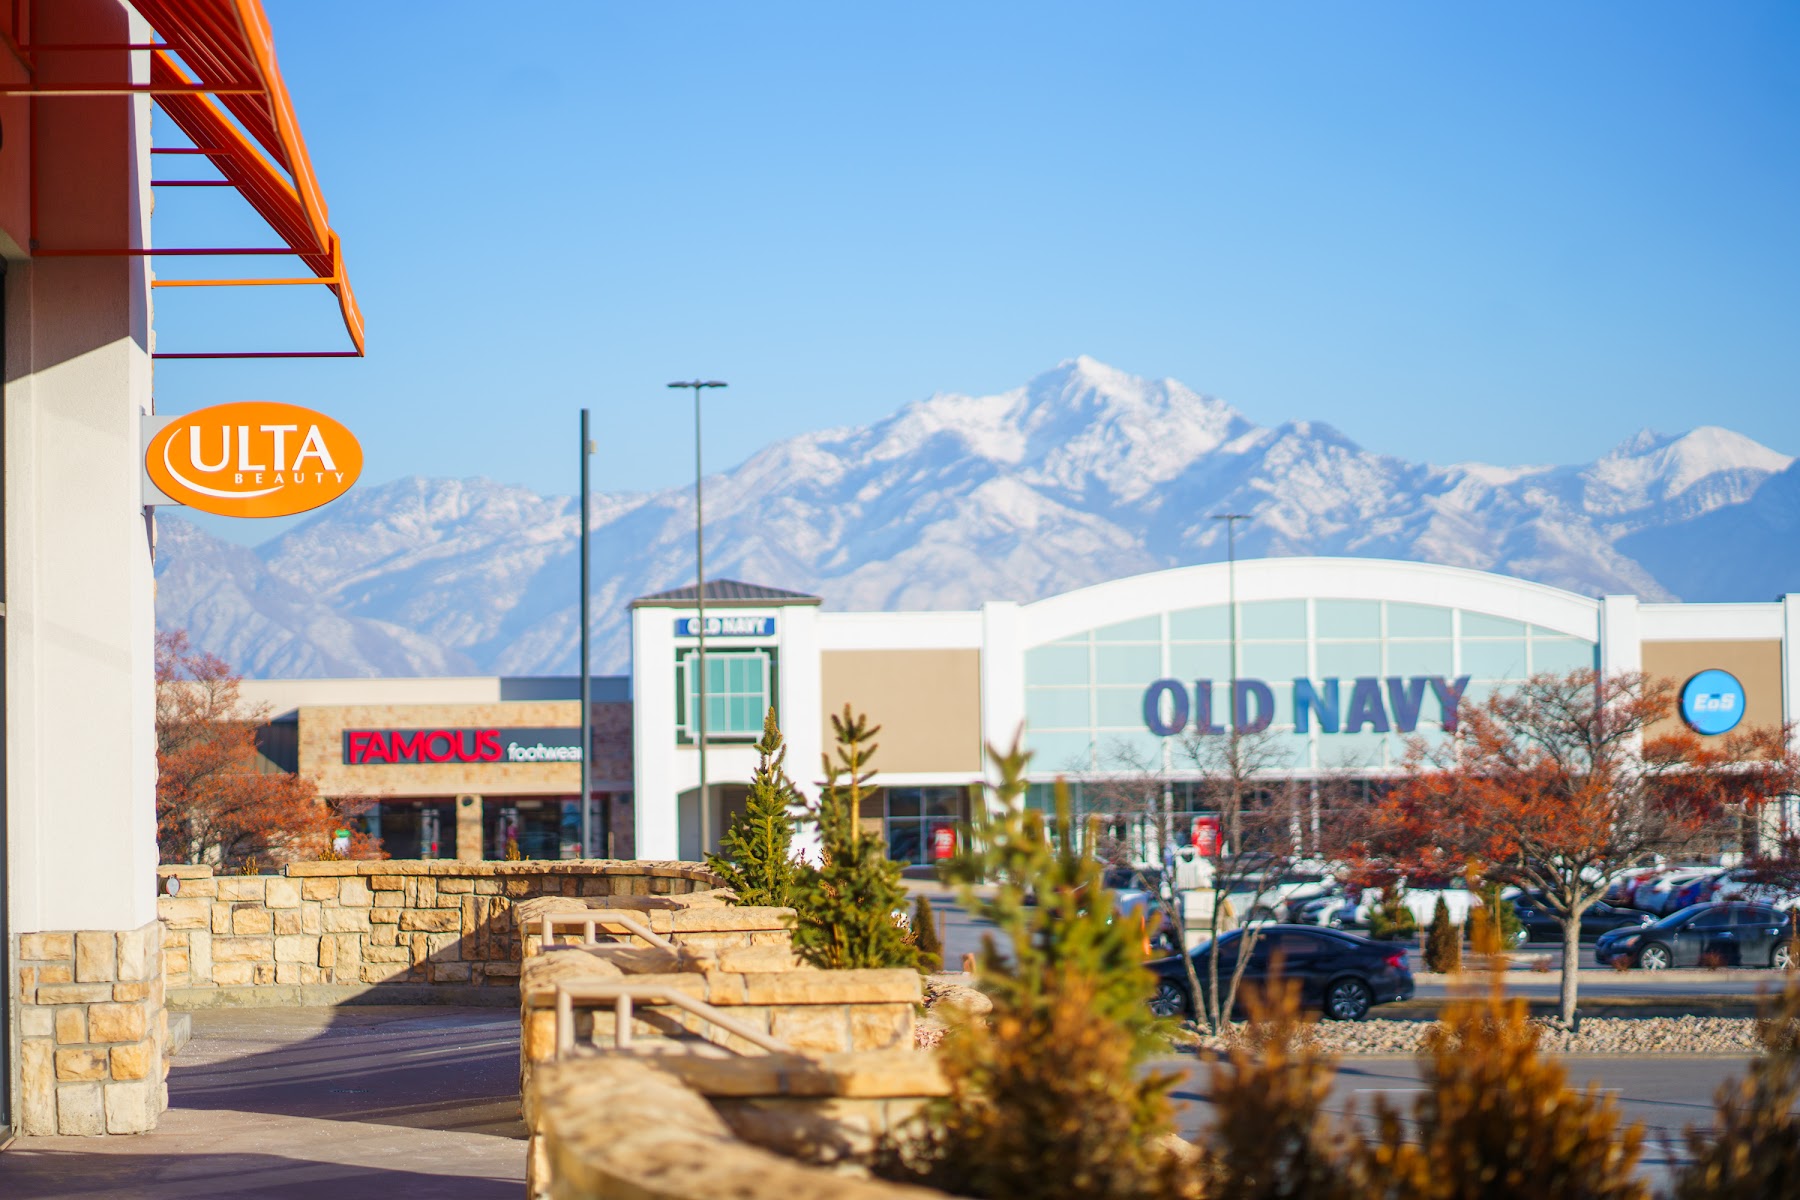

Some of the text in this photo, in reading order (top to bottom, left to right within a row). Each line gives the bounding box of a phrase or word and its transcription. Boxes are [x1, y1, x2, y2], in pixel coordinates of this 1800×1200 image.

[189, 424, 337, 473] ULTA
[234, 472, 345, 484] BEAUTY
[1143, 675, 1472, 736] OLD NAVY
[350, 729, 502, 764] FAMOUS
